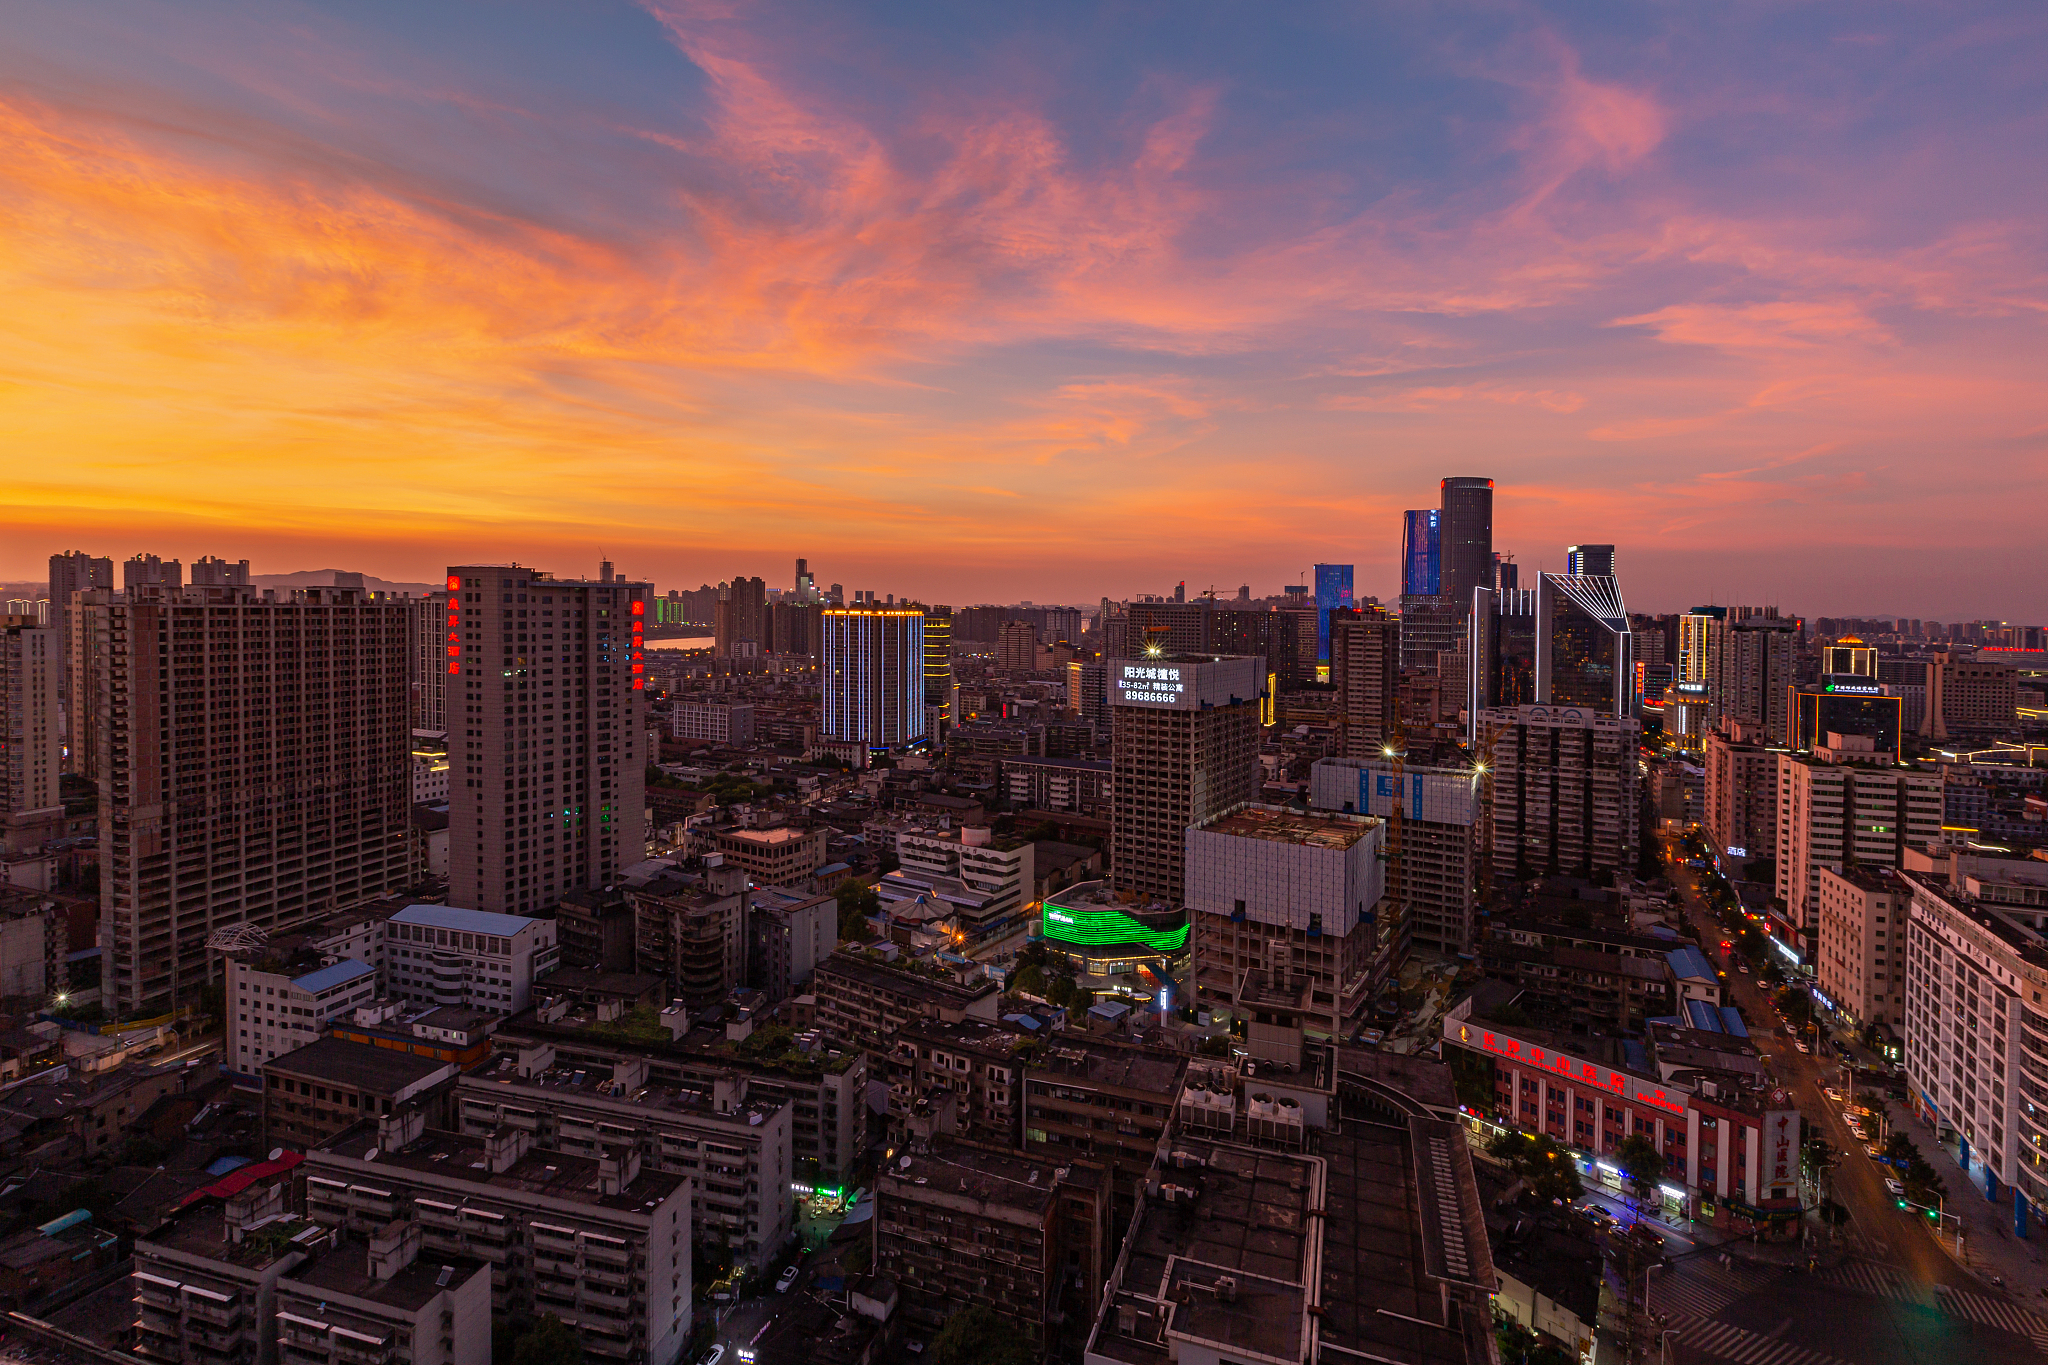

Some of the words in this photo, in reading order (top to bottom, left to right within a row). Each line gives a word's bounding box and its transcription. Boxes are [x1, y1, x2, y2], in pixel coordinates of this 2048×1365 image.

[1125, 690, 1176, 703] 89686666
[1483, 1031, 1626, 1090] 长沙中山医院
[1774, 1115, 1790, 1179] 中山医院
